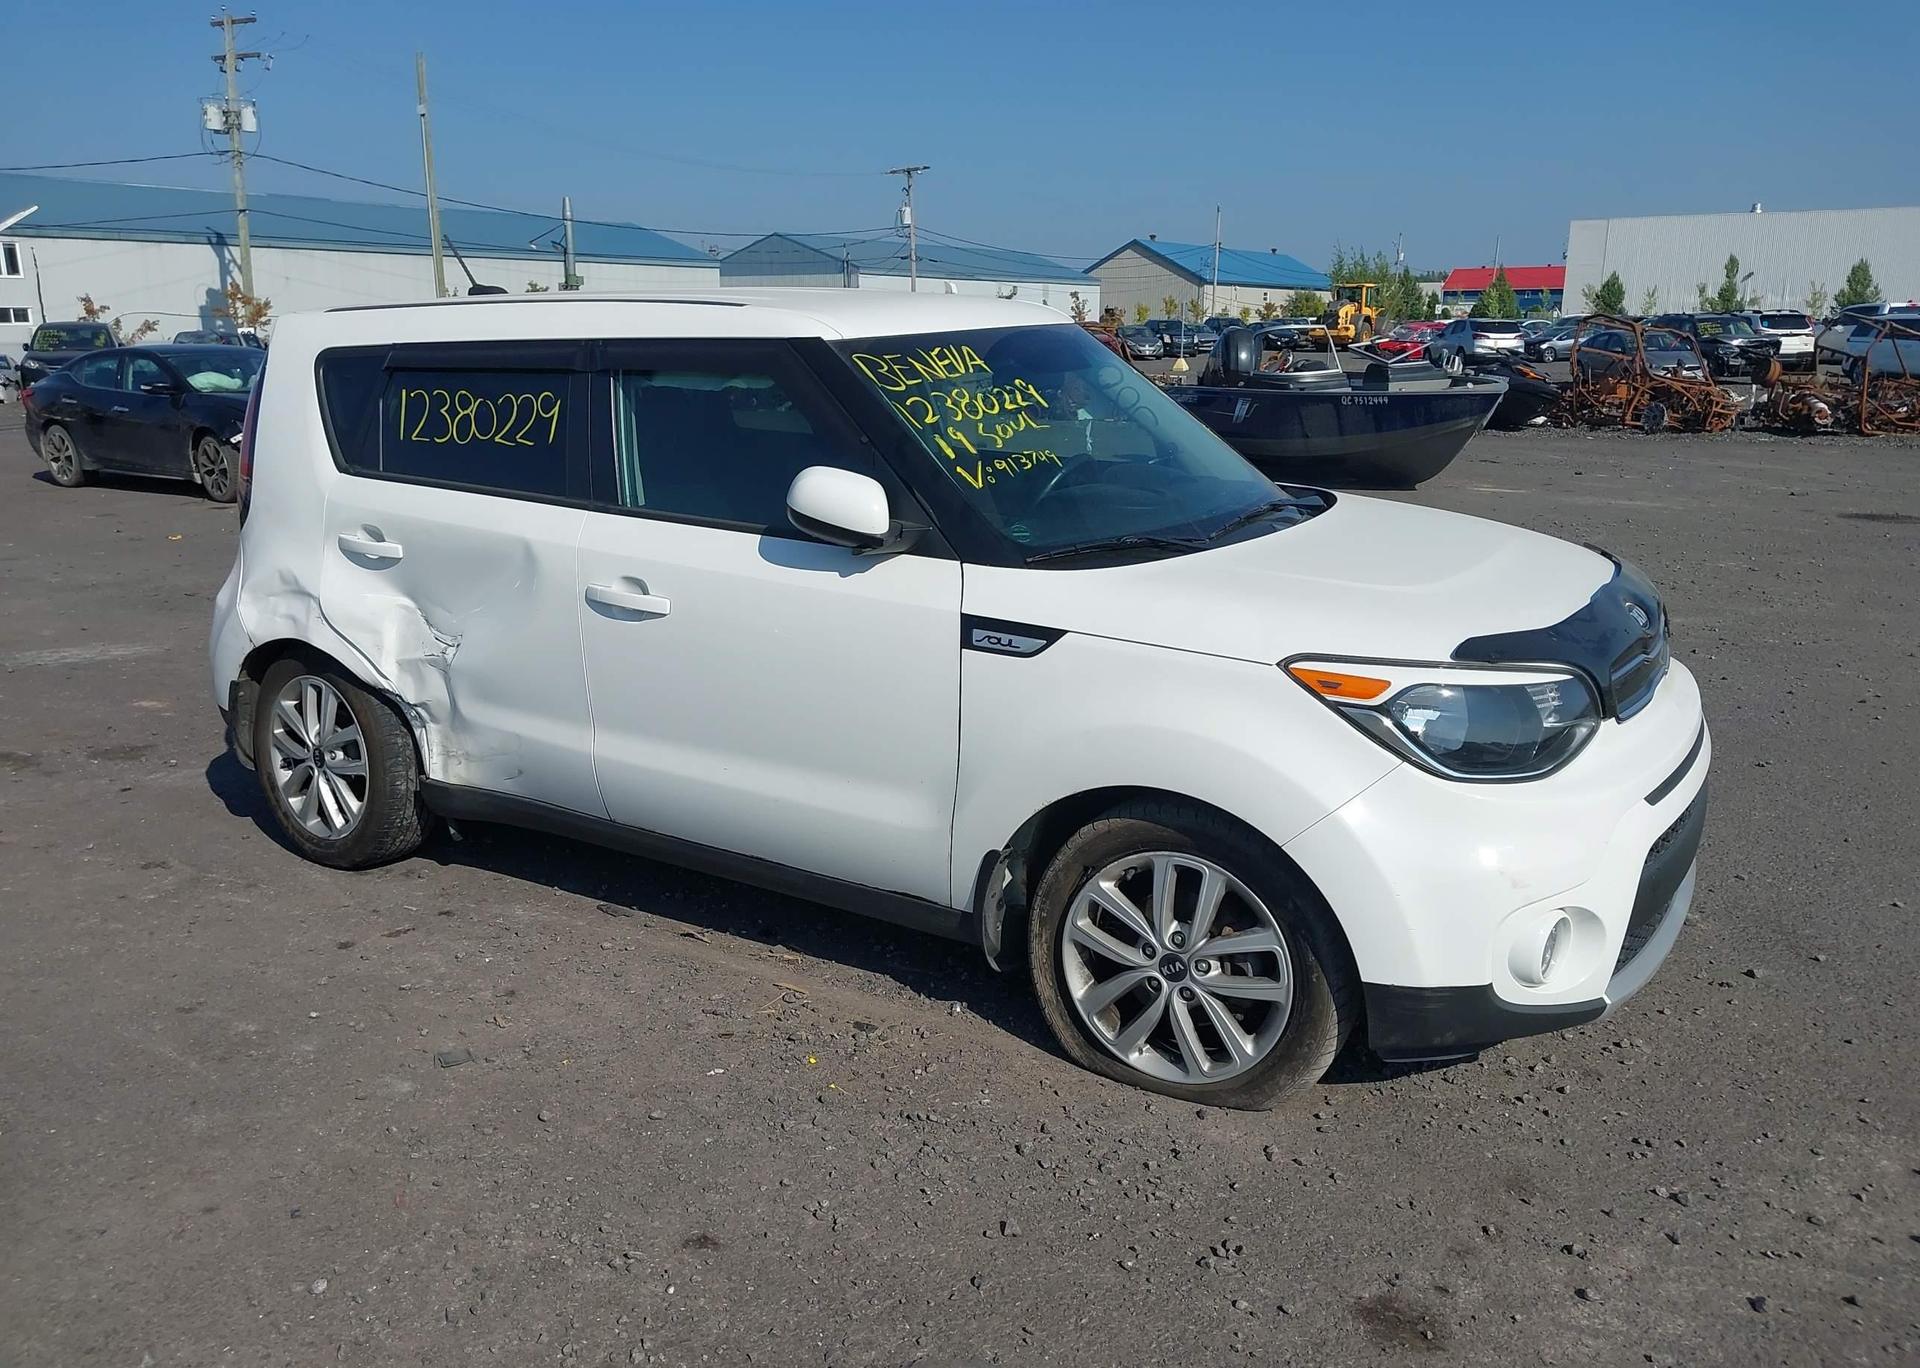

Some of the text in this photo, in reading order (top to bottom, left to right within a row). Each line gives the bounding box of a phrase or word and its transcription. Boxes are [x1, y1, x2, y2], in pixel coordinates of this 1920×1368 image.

[852, 344, 993, 391] BENEVA
[400, 388, 561, 446] 12380229
[892, 378, 1049, 430] 12380229
[1341, 396, 1352, 405] QC
[933, 426, 977, 460] 19
[1161, 961, 1185, 976] KIA
